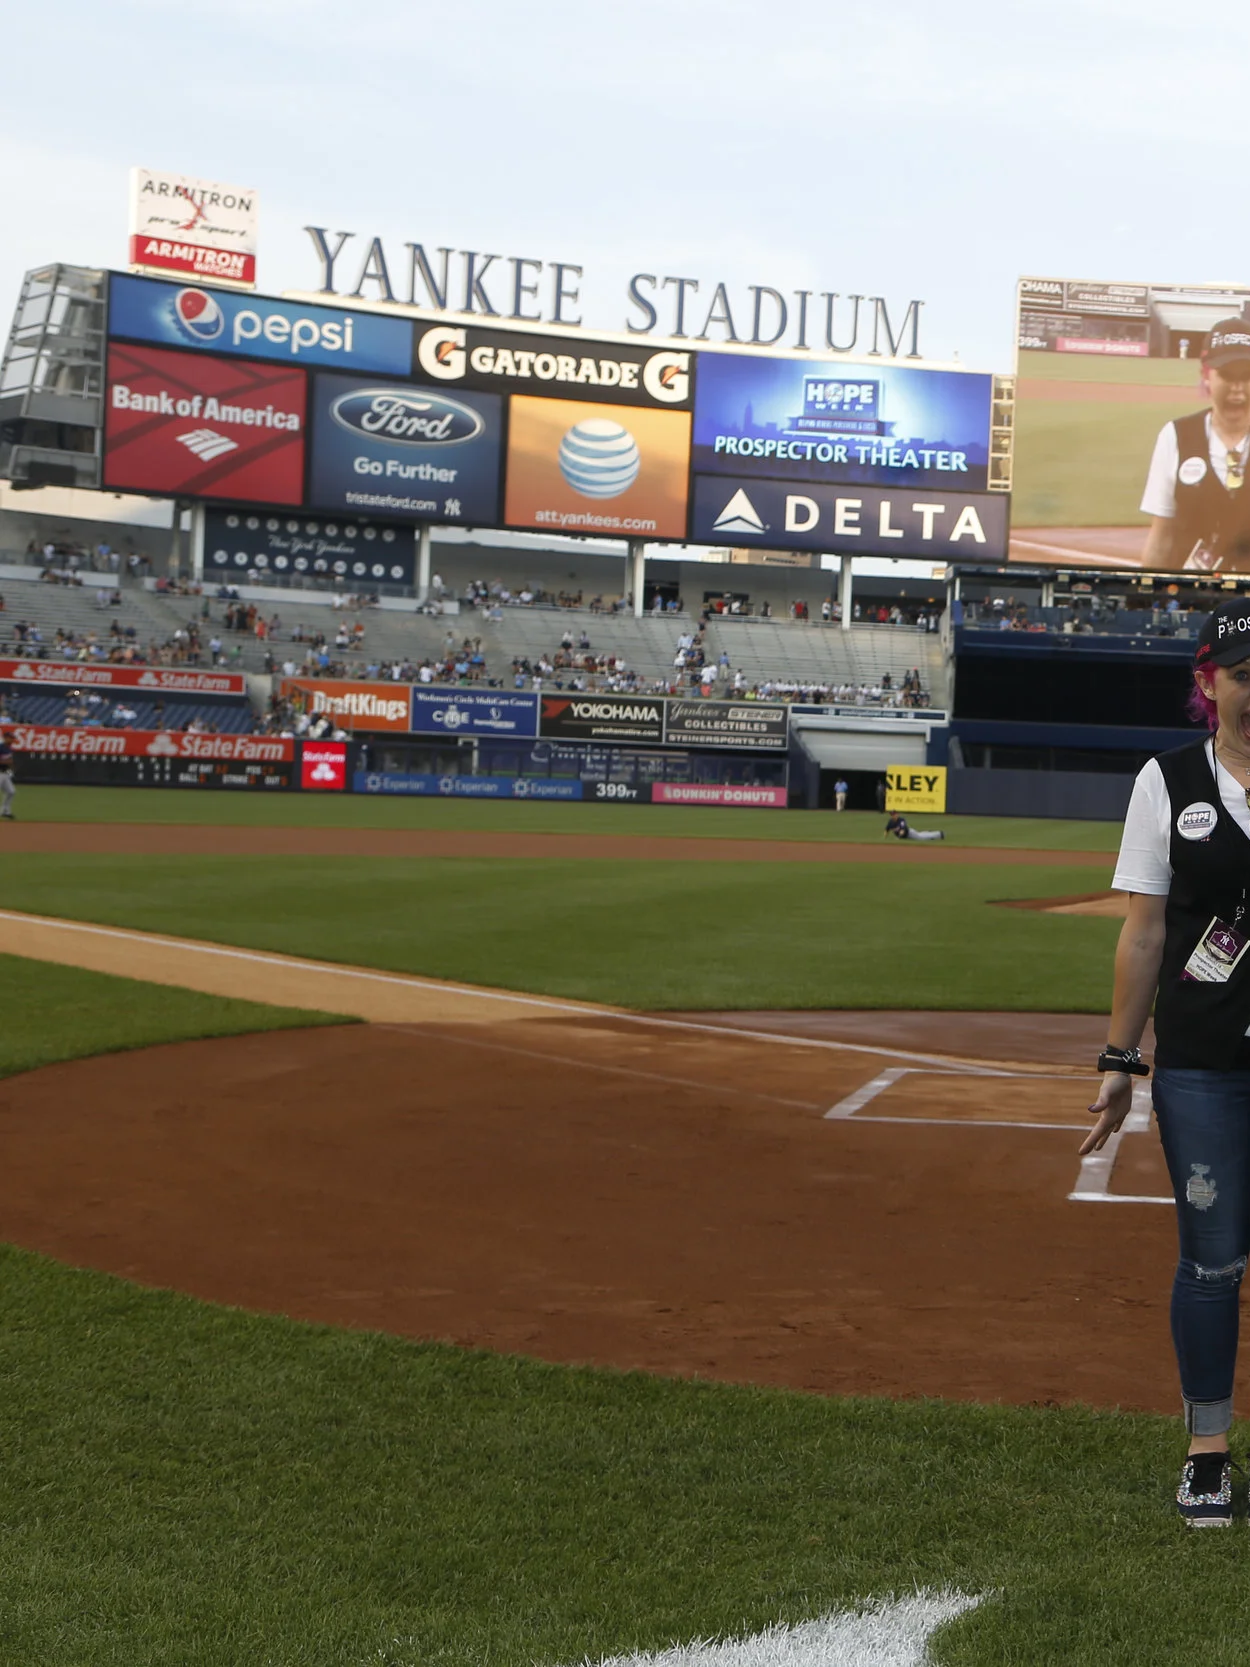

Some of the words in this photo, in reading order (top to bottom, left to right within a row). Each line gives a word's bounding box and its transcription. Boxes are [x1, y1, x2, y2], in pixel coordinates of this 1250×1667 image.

[142, 180, 251, 212] ARMITRON
[144, 240, 246, 270] ARMITRON
[304, 226, 583, 327] YANKEE
[626, 273, 924, 359] STADIUM
[233, 310, 354, 353] pepsi
[470, 346, 643, 389] GATORADE
[807, 383, 874, 404] HOPE
[112, 385, 174, 417] Bank
[174, 393, 202, 418] of
[204, 397, 300, 431] America
[361, 395, 453, 441] Ford
[714, 435, 848, 464] PROSPECTOR
[856, 445, 968, 472] THEATER
[354, 456, 383, 476] Go
[386, 457, 458, 482] Further
[345, 490, 437, 513] tristateford.com
[535, 509, 656, 531] att.yankees.com
[784, 495, 987, 544] DELTA
[1218, 616, 1229, 624] THE
[312, 690, 408, 721] DraftKings
[570, 702, 659, 721] YOKOHAMA
[670, 701, 720, 722] Yankees
[684, 719, 768, 732] COLLECTIBLES
[668, 734, 783, 746] STEINERSPORTS.COM
[383, 779, 426, 793] Experian
[455, 781, 498, 794] Experian
[531, 783, 573, 796] Experian
[672, 788, 723, 801] DUNKIN'
[723, 790, 775, 802] DONUTS
